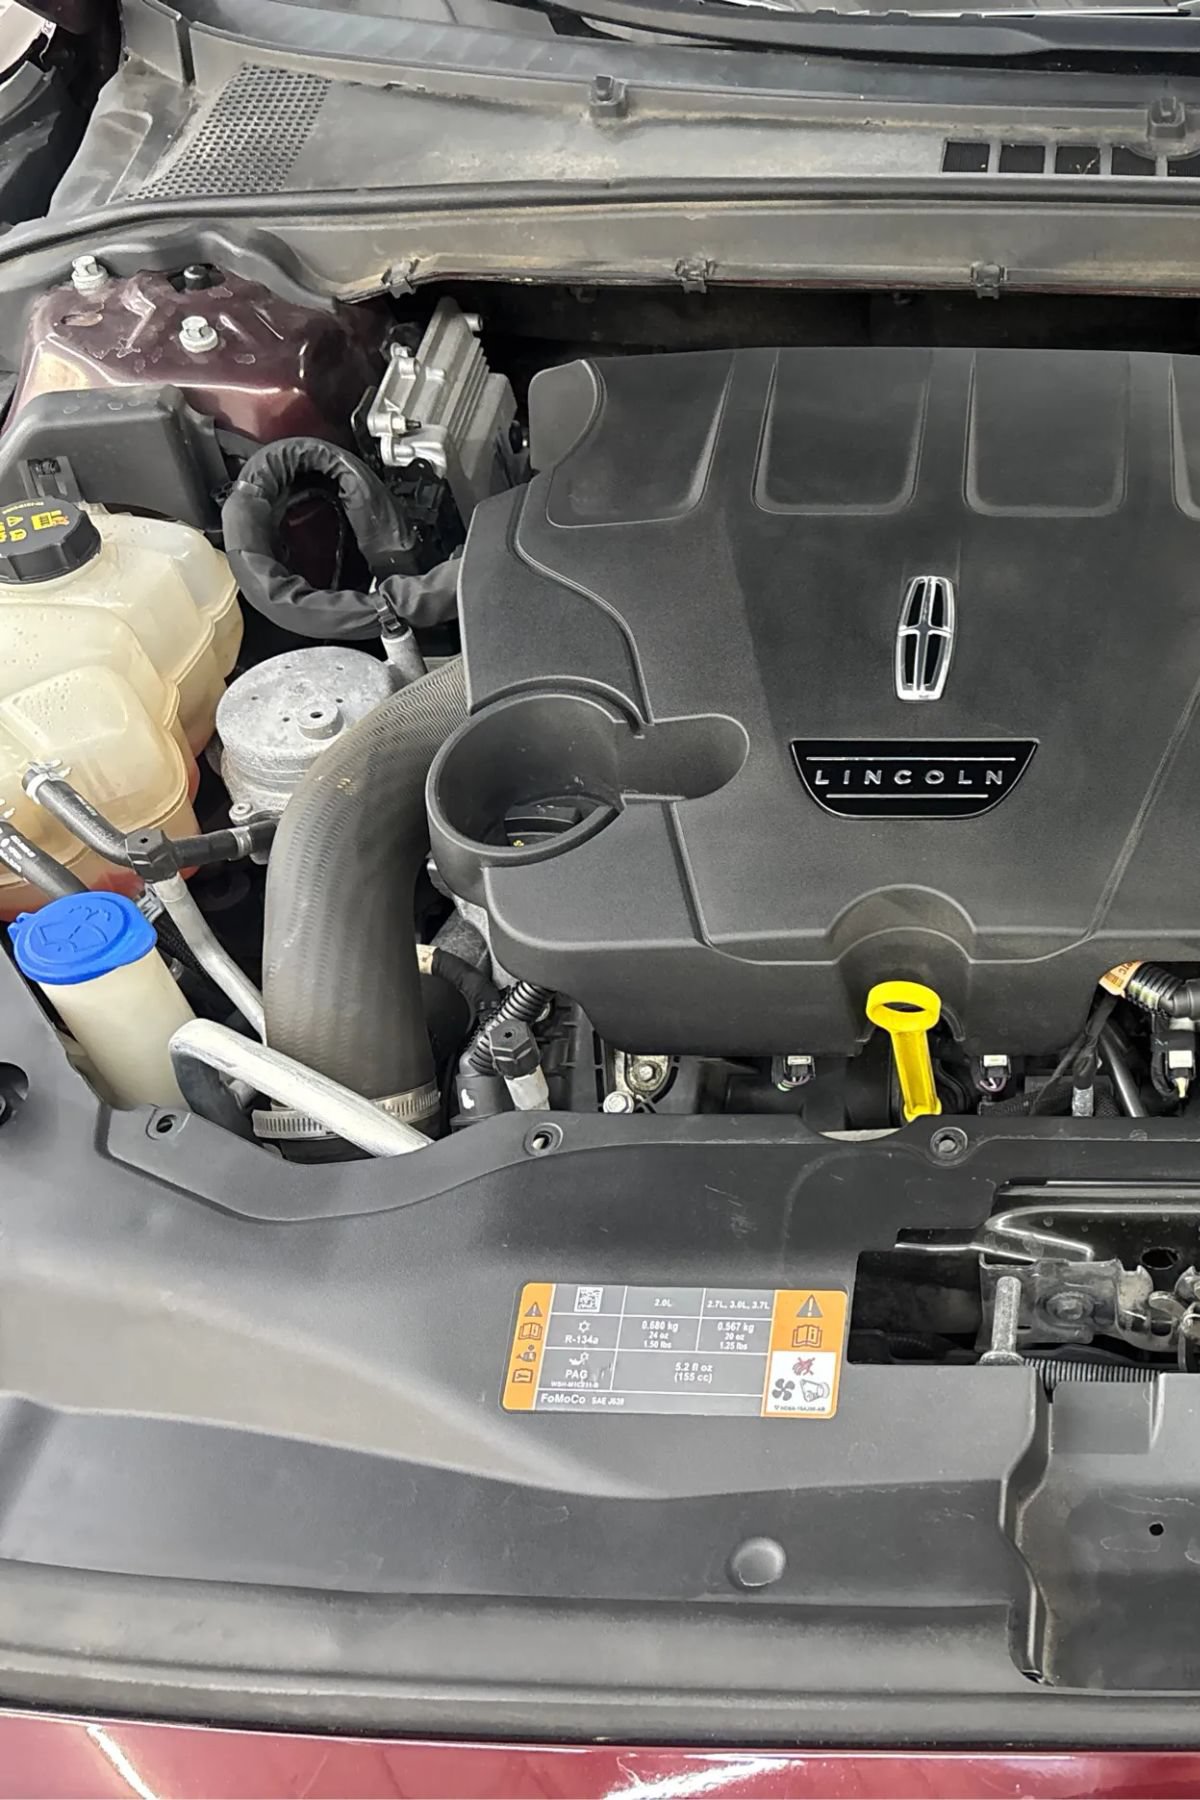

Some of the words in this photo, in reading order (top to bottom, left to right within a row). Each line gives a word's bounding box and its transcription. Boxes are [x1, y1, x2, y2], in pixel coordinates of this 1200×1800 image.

[814, 769, 1004, 785] LINCOLN
[654, 1298, 672, 1308] 2.0L
[641, 1320, 665, 1331] 0.680
[667, 1321, 679, 1332] kg
[717, 1321, 742, 1332] 0.567
[743, 1322, 755, 1334] kg
[564, 1335, 599, 1345] R-134a
[648, 1331, 658, 1339] 24
[724, 1333, 735, 1341] 20
[643, 1340, 659, 1349] 1.50
[660, 1341, 672, 1349] lbs
[719, 1342, 735, 1350] 1.25
[736, 1342, 748, 1350] lbs
[674, 1362, 690, 1372] 5.2
[700, 1363, 713, 1372] oz
[565, 1369, 588, 1380] PAG
[674, 1372, 695, 1383] (155
[696, 1373, 712, 1384] cc)
[540, 1393, 586, 1404] FoMoCo
[591, 1397, 606, 1405] SAE
